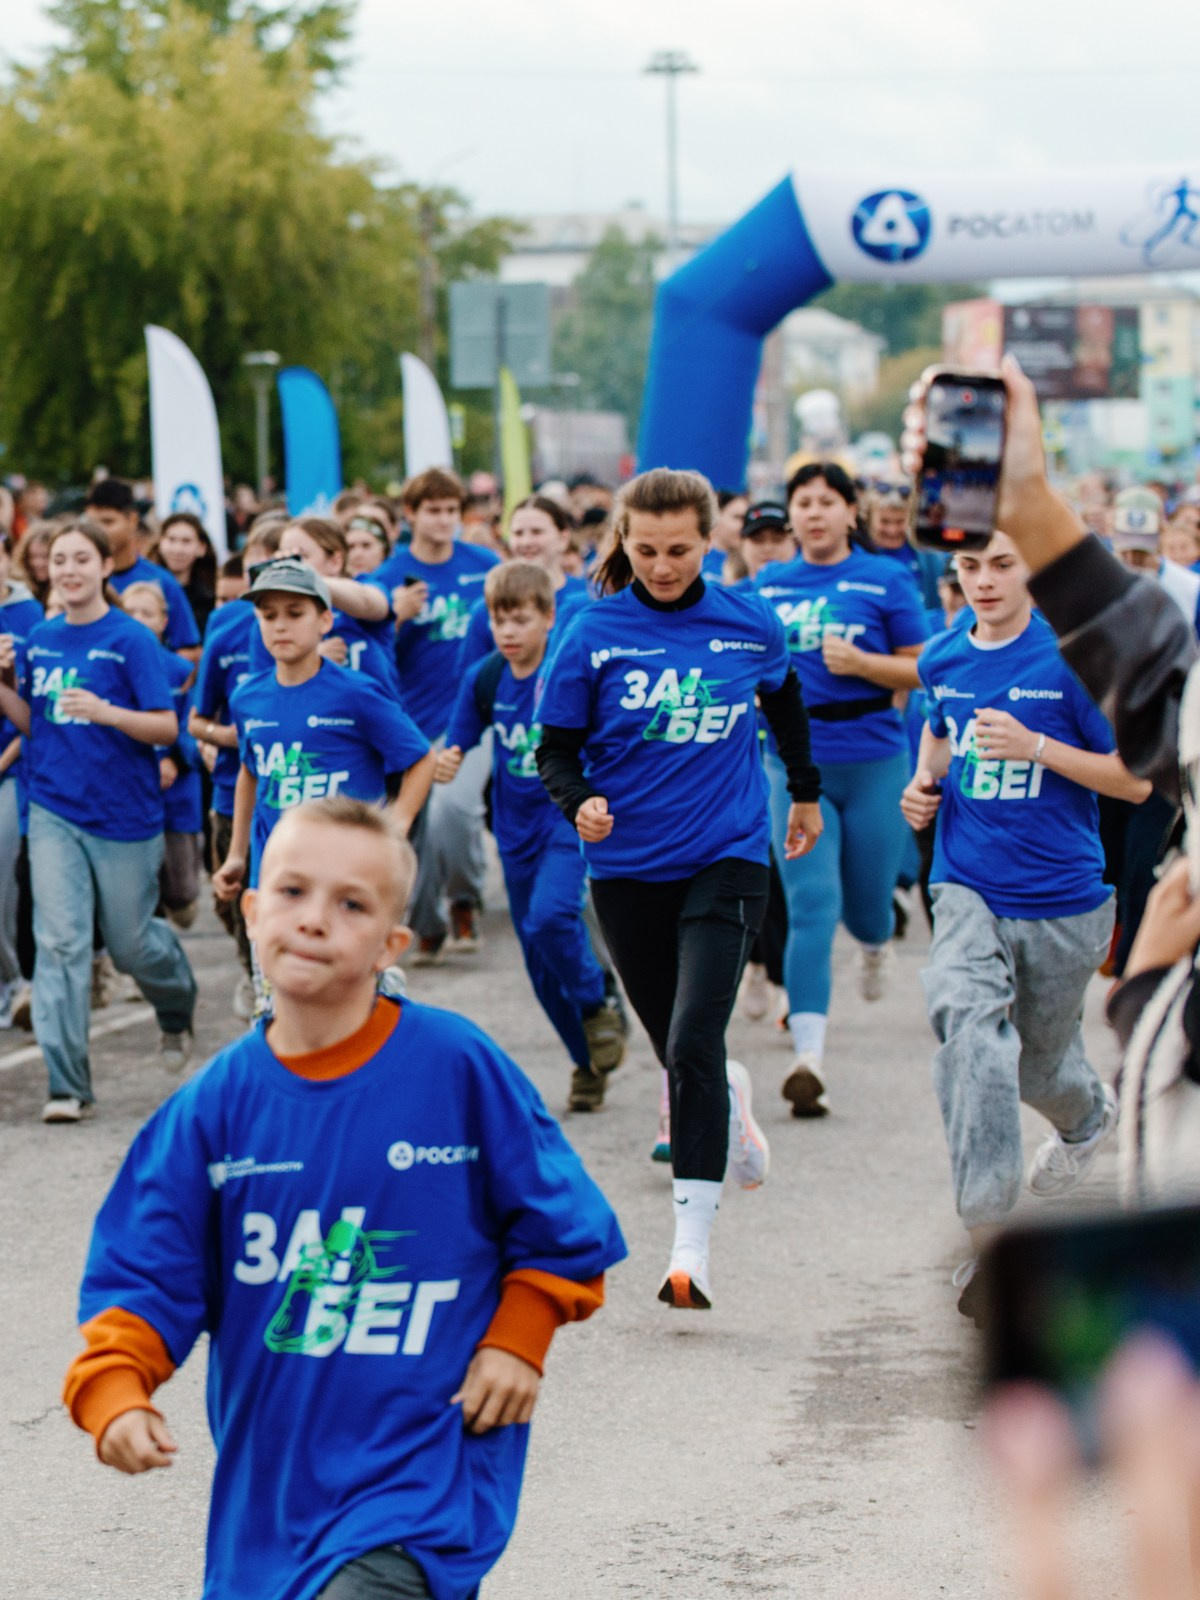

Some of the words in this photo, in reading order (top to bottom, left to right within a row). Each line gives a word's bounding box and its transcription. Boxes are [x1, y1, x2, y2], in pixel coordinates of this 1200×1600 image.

[949, 210, 1096, 239] РОСАТОМ
[619, 667, 702, 711] ЗА!
[1020, 689, 1063, 700] РОСАТОМ
[666, 702, 749, 744] БЕГ
[279, 770, 349, 809] БЕГ
[233, 1206, 367, 1285] ЗА!
[303, 1278, 461, 1358] БЕГ
